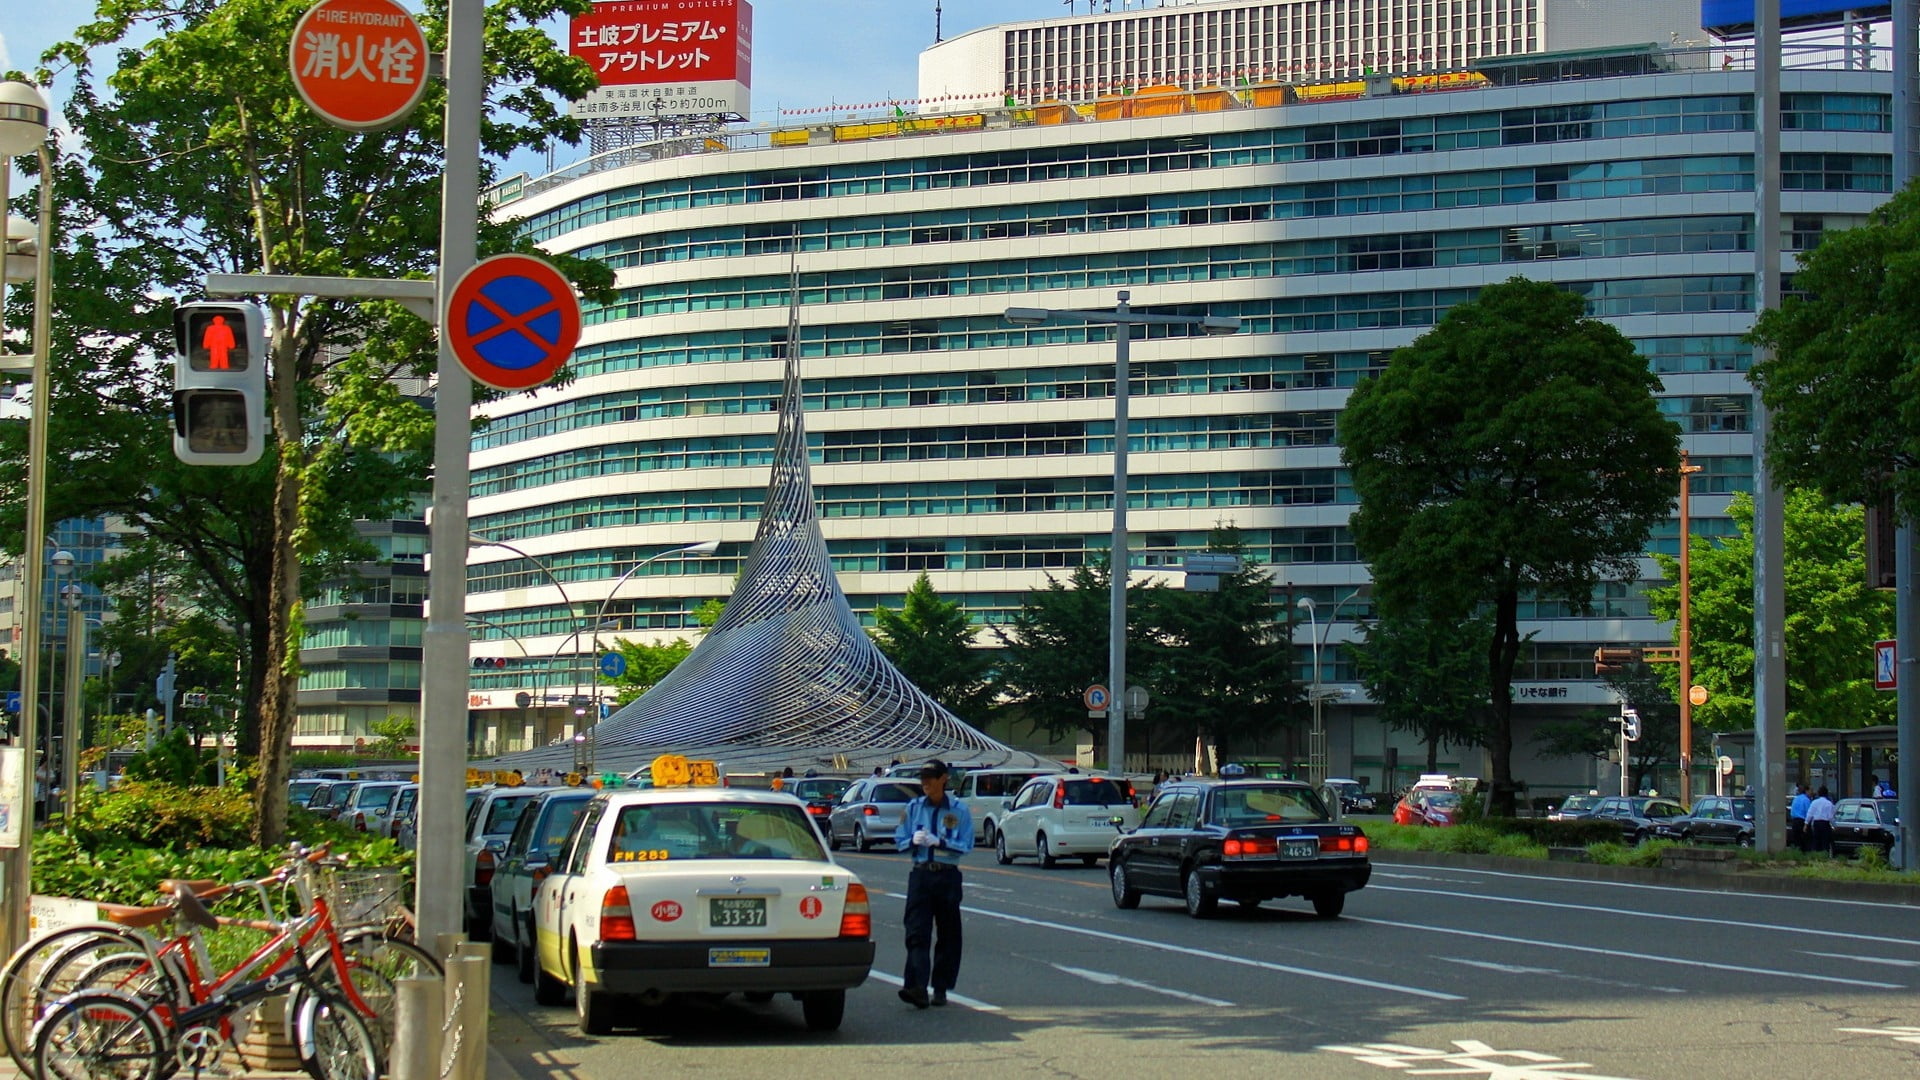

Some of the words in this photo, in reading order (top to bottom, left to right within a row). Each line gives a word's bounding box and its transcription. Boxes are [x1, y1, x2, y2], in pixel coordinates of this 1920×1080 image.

[612, 3, 669, 13] PREMIUM
[678, 0, 733, 9] OUTLETS
[316, 10, 347, 24] FIRE
[349, 11, 407, 27] HYDRANT
[302, 31, 417, 84] 消火栓
[599, 48, 710, 72] アウトレット
[605, 87, 697, 99] 東海環状自動車道
[1520, 687, 1568, 698] りそな銀行
[654, 904, 679, 918] 小型
[722, 909, 764, 925] 33-37
